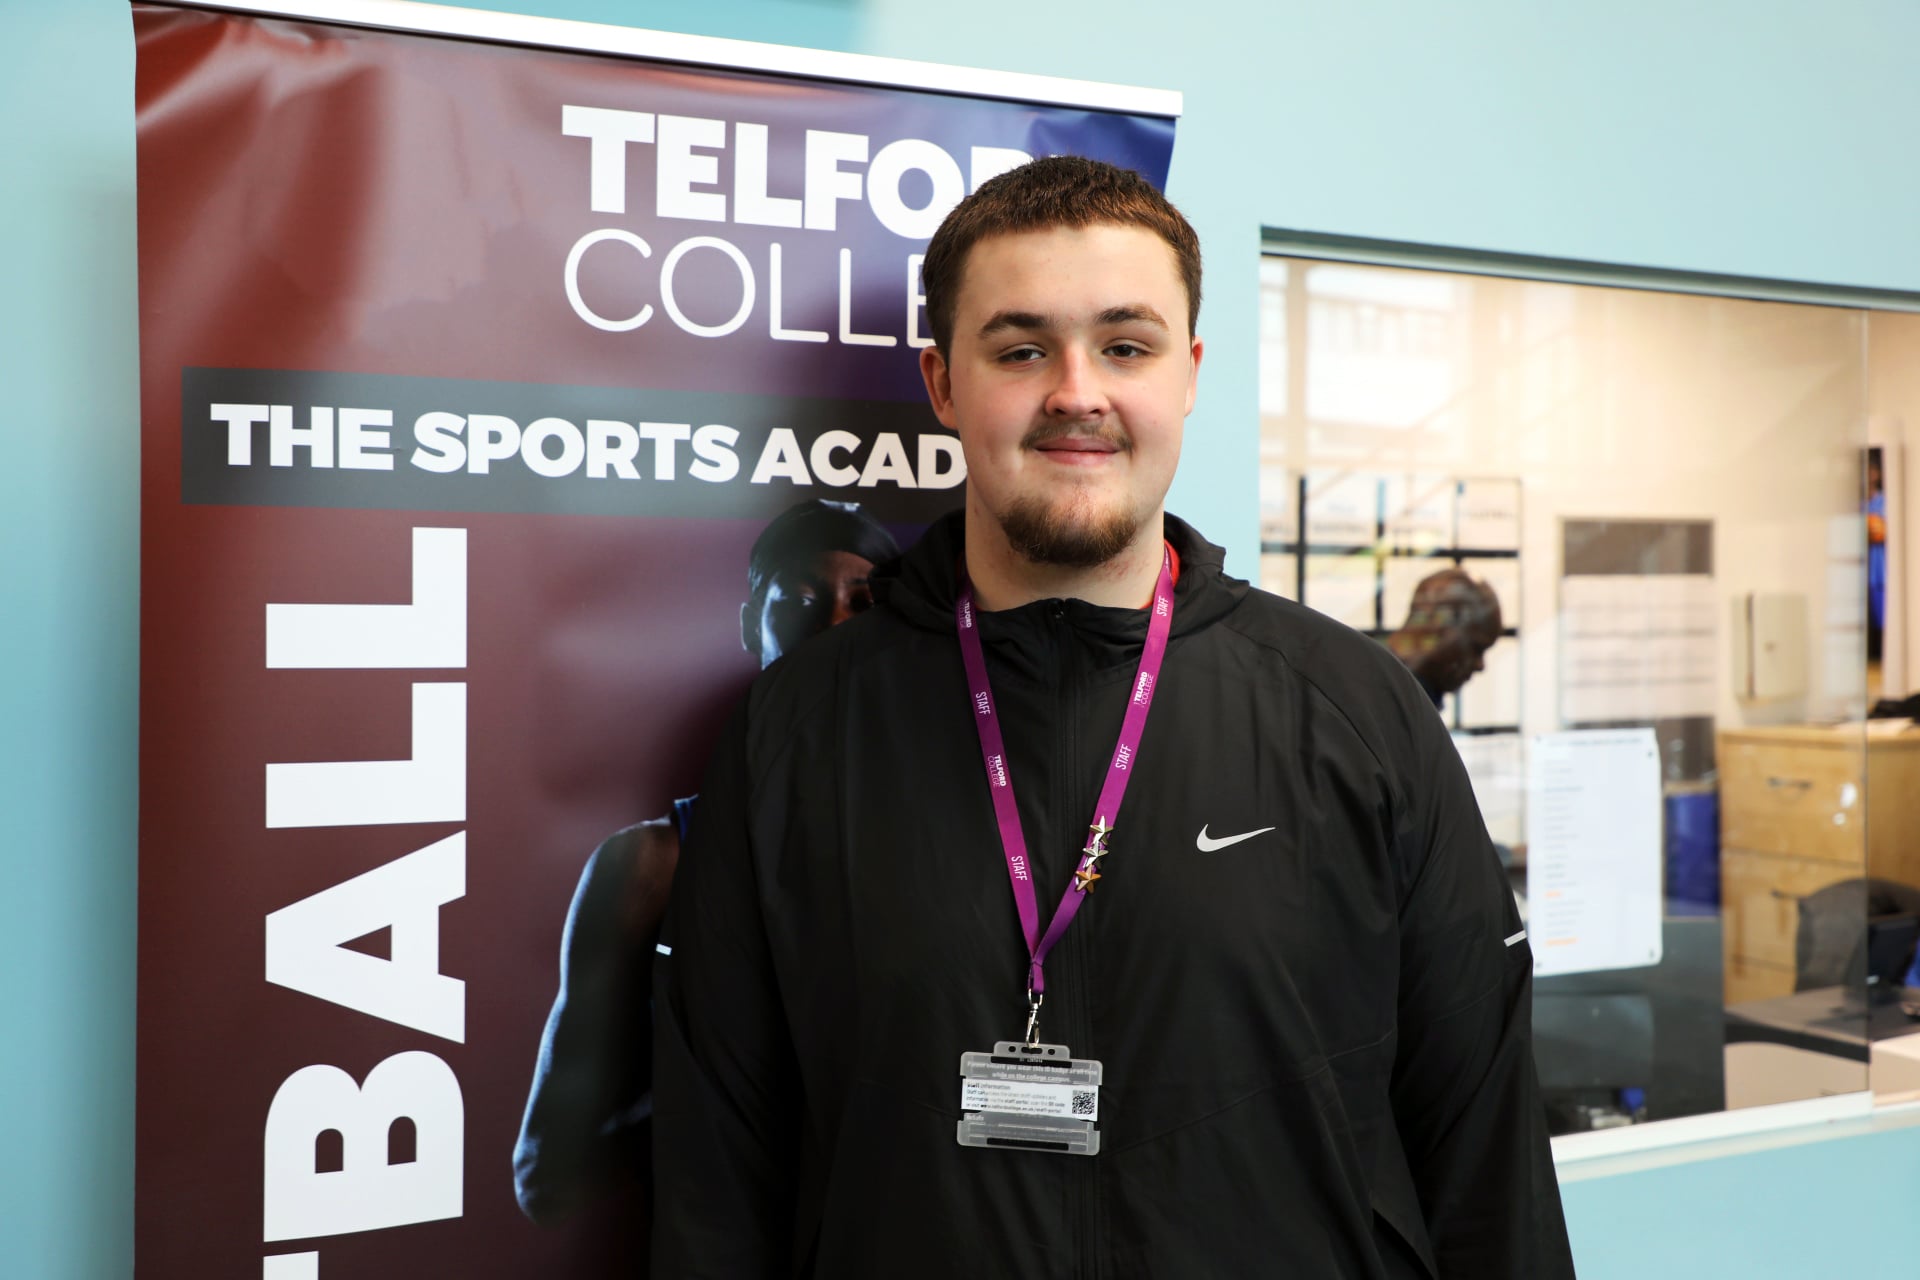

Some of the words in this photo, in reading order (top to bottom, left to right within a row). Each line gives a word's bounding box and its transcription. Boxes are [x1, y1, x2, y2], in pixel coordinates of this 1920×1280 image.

[562, 104, 1035, 240] TELFO
[564, 228, 940, 348] COLLE
[210, 403, 395, 471] THE
[411, 411, 741, 484] SPORTS
[750, 428, 968, 490] ACAD
[1156, 595, 1169, 617] STAFF
[1134, 671, 1148, 702] TELFORD
[1141, 673, 1154, 705] COLLEGE
[975, 691, 991, 715] STAFF
[988, 755, 1000, 788] COLLEGE
[994, 754, 1007, 787] TELFORD
[1115, 743, 1132, 770] STAFF
[1011, 855, 1028, 881] STAFF
